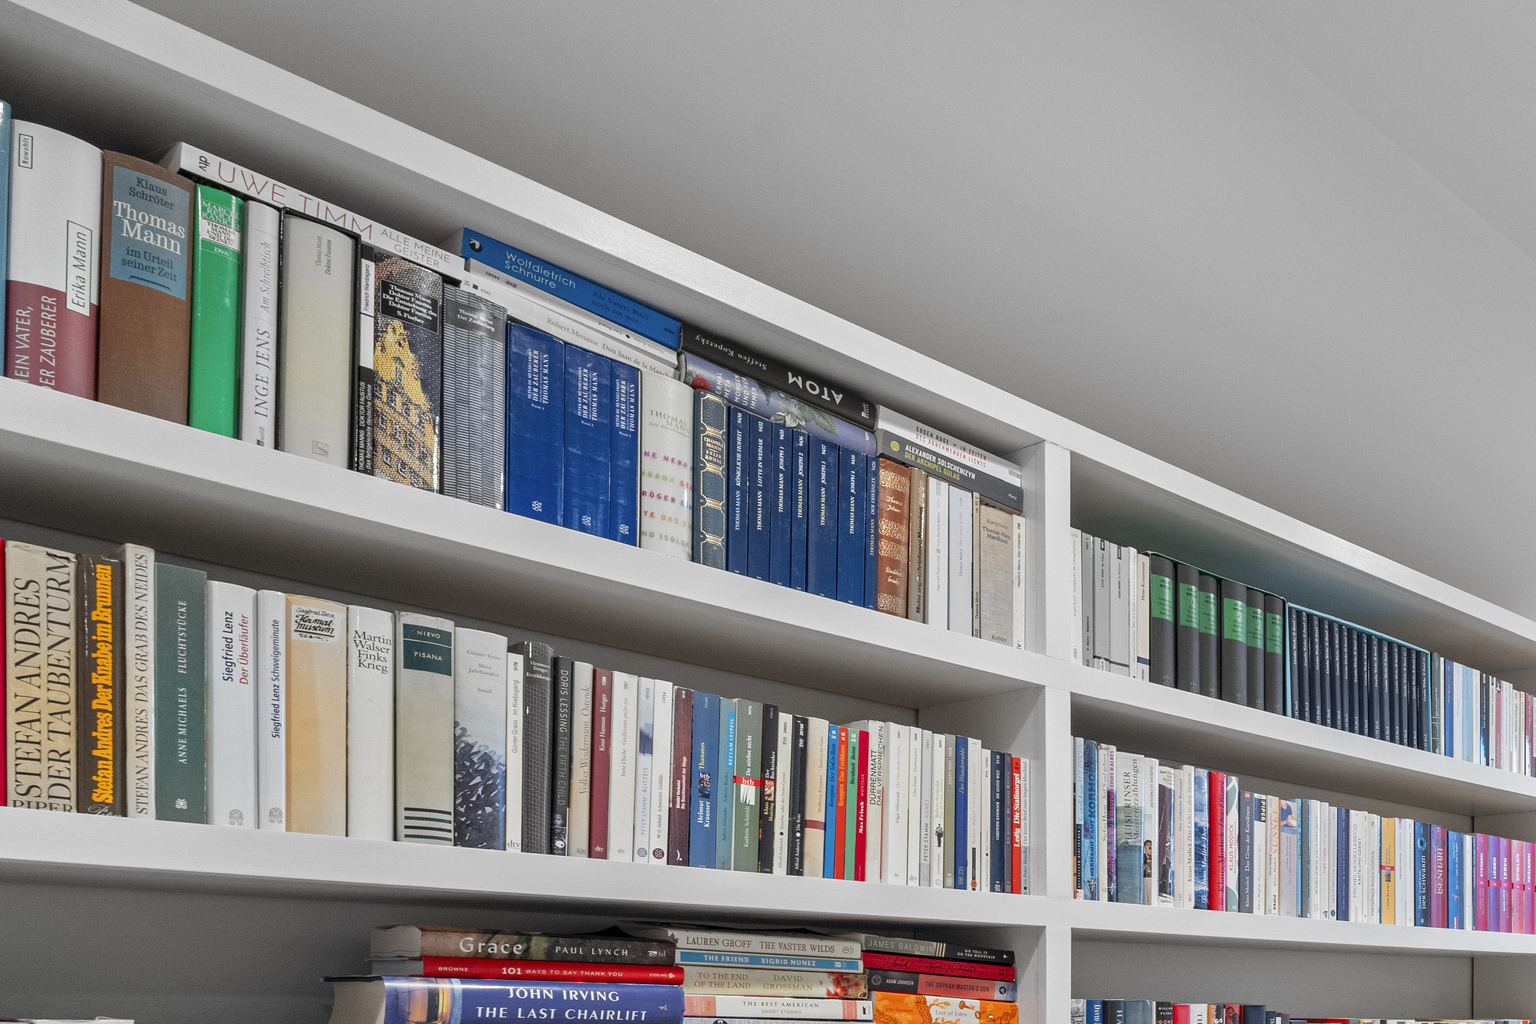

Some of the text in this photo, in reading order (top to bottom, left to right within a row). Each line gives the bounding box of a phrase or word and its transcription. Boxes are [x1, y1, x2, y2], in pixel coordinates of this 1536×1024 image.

[198, 156, 373, 240] dtv UWE TIMM
[113, 200, 186, 239] Thomas
[121, 218, 182, 255] Mann
[381, 228, 450, 263] ALLE MEINE
[394, 243, 439, 268] GEISTER
[71, 232, 86, 308] Erika Mann
[505, 260, 557, 289] Schnurre
[506, 251, 576, 289] Wolfdietrich
[41, 296, 57, 365] ZAUBERER
[695, 334, 767, 371] Steffen Kopetzky
[255, 328, 270, 418] INGE JENS
[788, 371, 843, 405] ATOM
[906, 444, 975, 480] ALEXANDER SOLSCHENIZYN
[223, 612, 233, 682] Siegfried Lenz
[240, 614, 249, 685] Der Überläufer
[354, 629, 392, 646] Martin
[354, 640, 390, 655] Walser
[416, 629, 440, 639] NIEVO
[357, 649, 387, 663] Finks
[357, 659, 388, 674] Krieg
[414, 651, 443, 662] PISANA
[14, 577, 42, 798] STEFAN ANDRES
[46, 551, 72, 802] DER TAUBENTURM
[91, 564, 114, 804] Stefan Andres Der Knabe im Brunnen
[178, 600, 187, 764] ANNE MICHAELS FLUCHTSTÜCKE
[560, 692, 568, 733] LESSING
[869, 749, 877, 805] DÜRRENMATT
[460, 937, 629, 956] Grace PAUL LYNCH
[686, 937, 835, 953] LAUREN GROFF THE VASTER WILDS
[476, 1006, 647, 1021] THE LAST CHAIRLIFT
[509, 988, 620, 1002] JOHN IRVING
